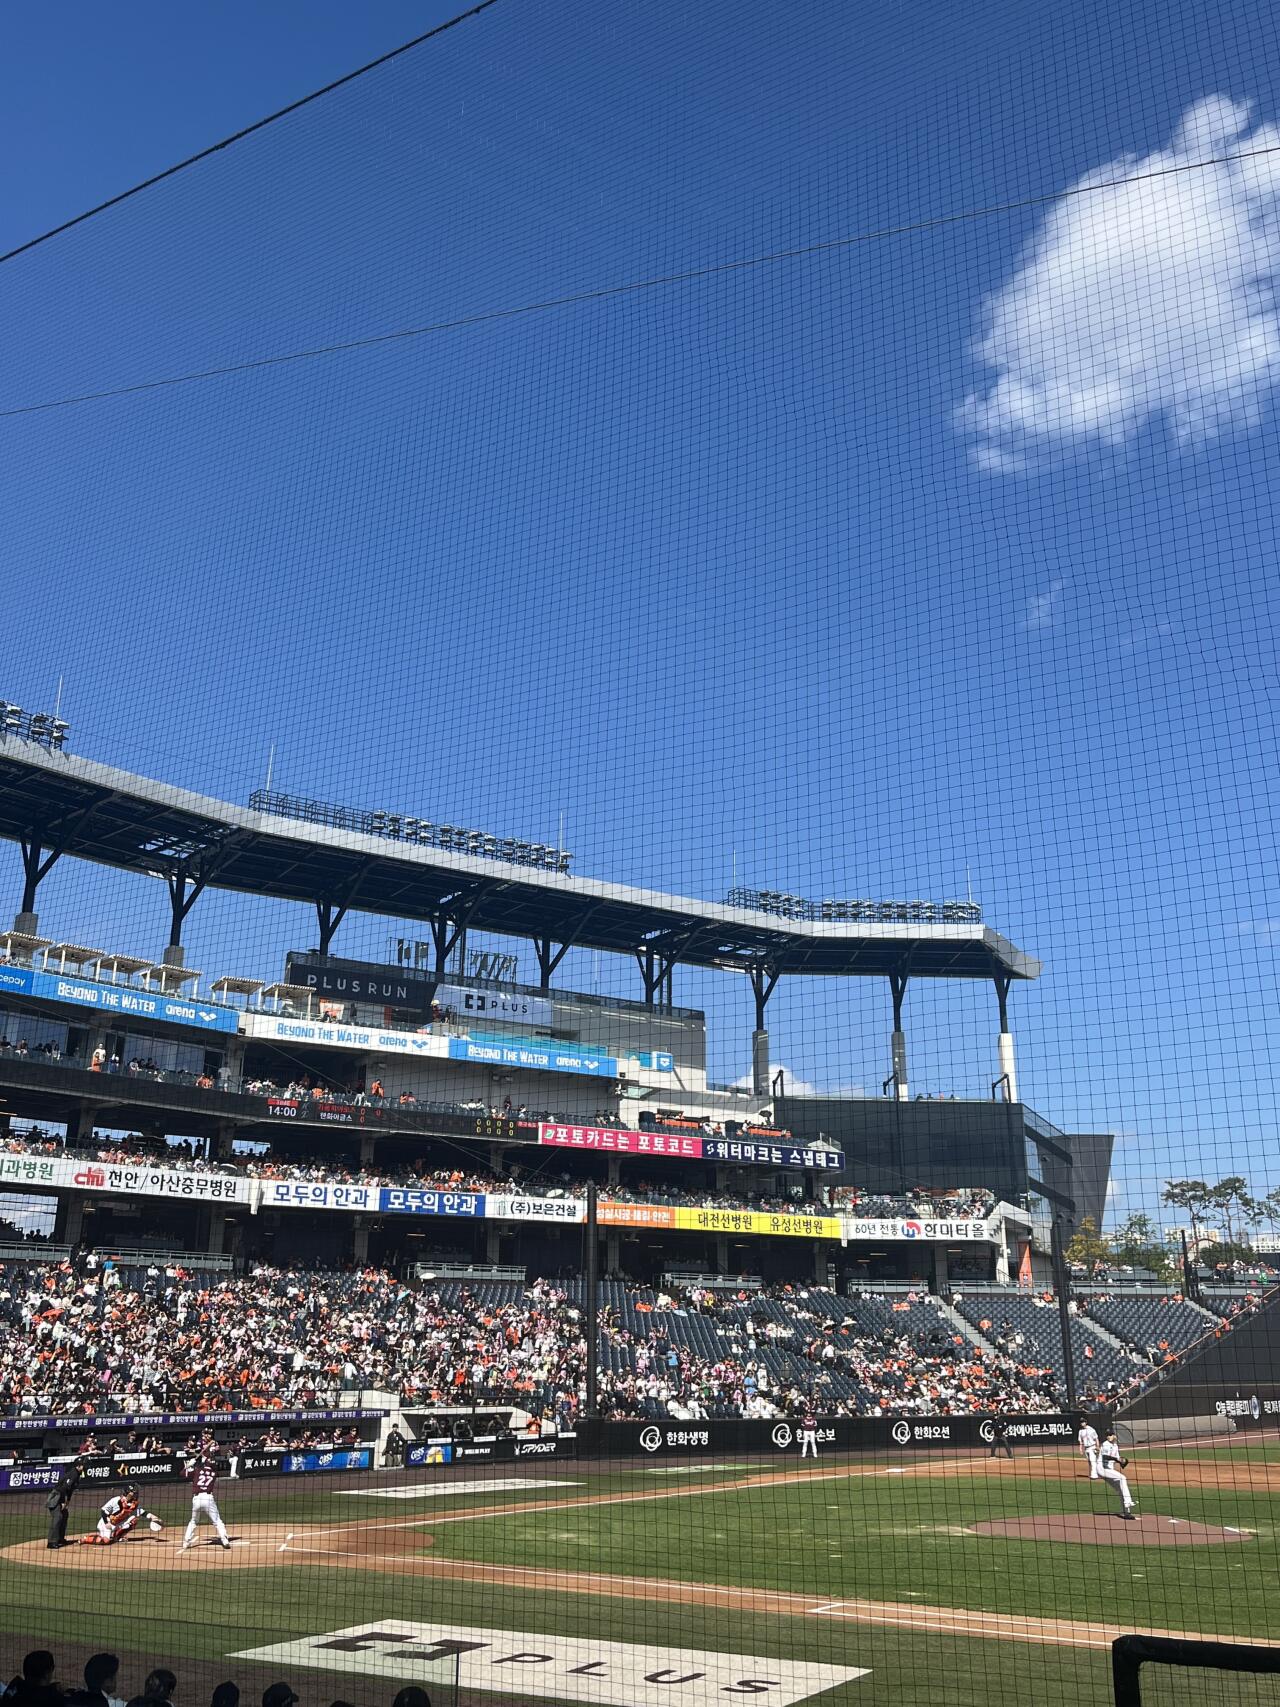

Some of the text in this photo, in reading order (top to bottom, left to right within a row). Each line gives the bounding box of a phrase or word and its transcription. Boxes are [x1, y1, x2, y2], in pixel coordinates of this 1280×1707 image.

[58, 982, 156, 1013] BEYOND THE WATER
[166, 1004, 196, 1019] arena
[491, 1001, 528, 1014] PLUS
[277, 1023, 370, 1045] BEYOND THE WATER
[379, 1037, 408, 1048] arena
[468, 1044, 549, 1065] BEYOND THE WATER
[556, 1056, 581, 1067] arena
[268, 1106, 297, 1117] 14:00
[556, 1128, 694, 1155] 포토카드는 포토코드
[717, 1142, 841, 1169] 워터마크는 스냅태그
[273, 1185, 370, 1208] 모두의 안과
[388, 1191, 477, 1215] 모두의 안과
[510, 1200, 577, 1217] (주)보은건설
[698, 1212, 753, 1231] 대전선병원
[770, 1216, 824, 1234] 유성선병원
[855, 1223, 899, 1237] 60년 전통
[924, 1223, 985, 1238] 한미타올
[796, 1428, 836, 1443] 한손보
[914, 1426, 950, 1440] 한화오션
[1004, 1423, 1073, 1437] 화에어로스페이스
[667, 1431, 709, 1446] 한화생명
[521, 1443, 556, 1453] SPYDER
[87, 1466, 110, 1478] 아워홈
[129, 1463, 172, 1476] OURHOME
[10, 1471, 60, 1487] 정한방병원
[197, 1475, 213, 1486] 27
[491, 1652, 783, 1696] PLUS
